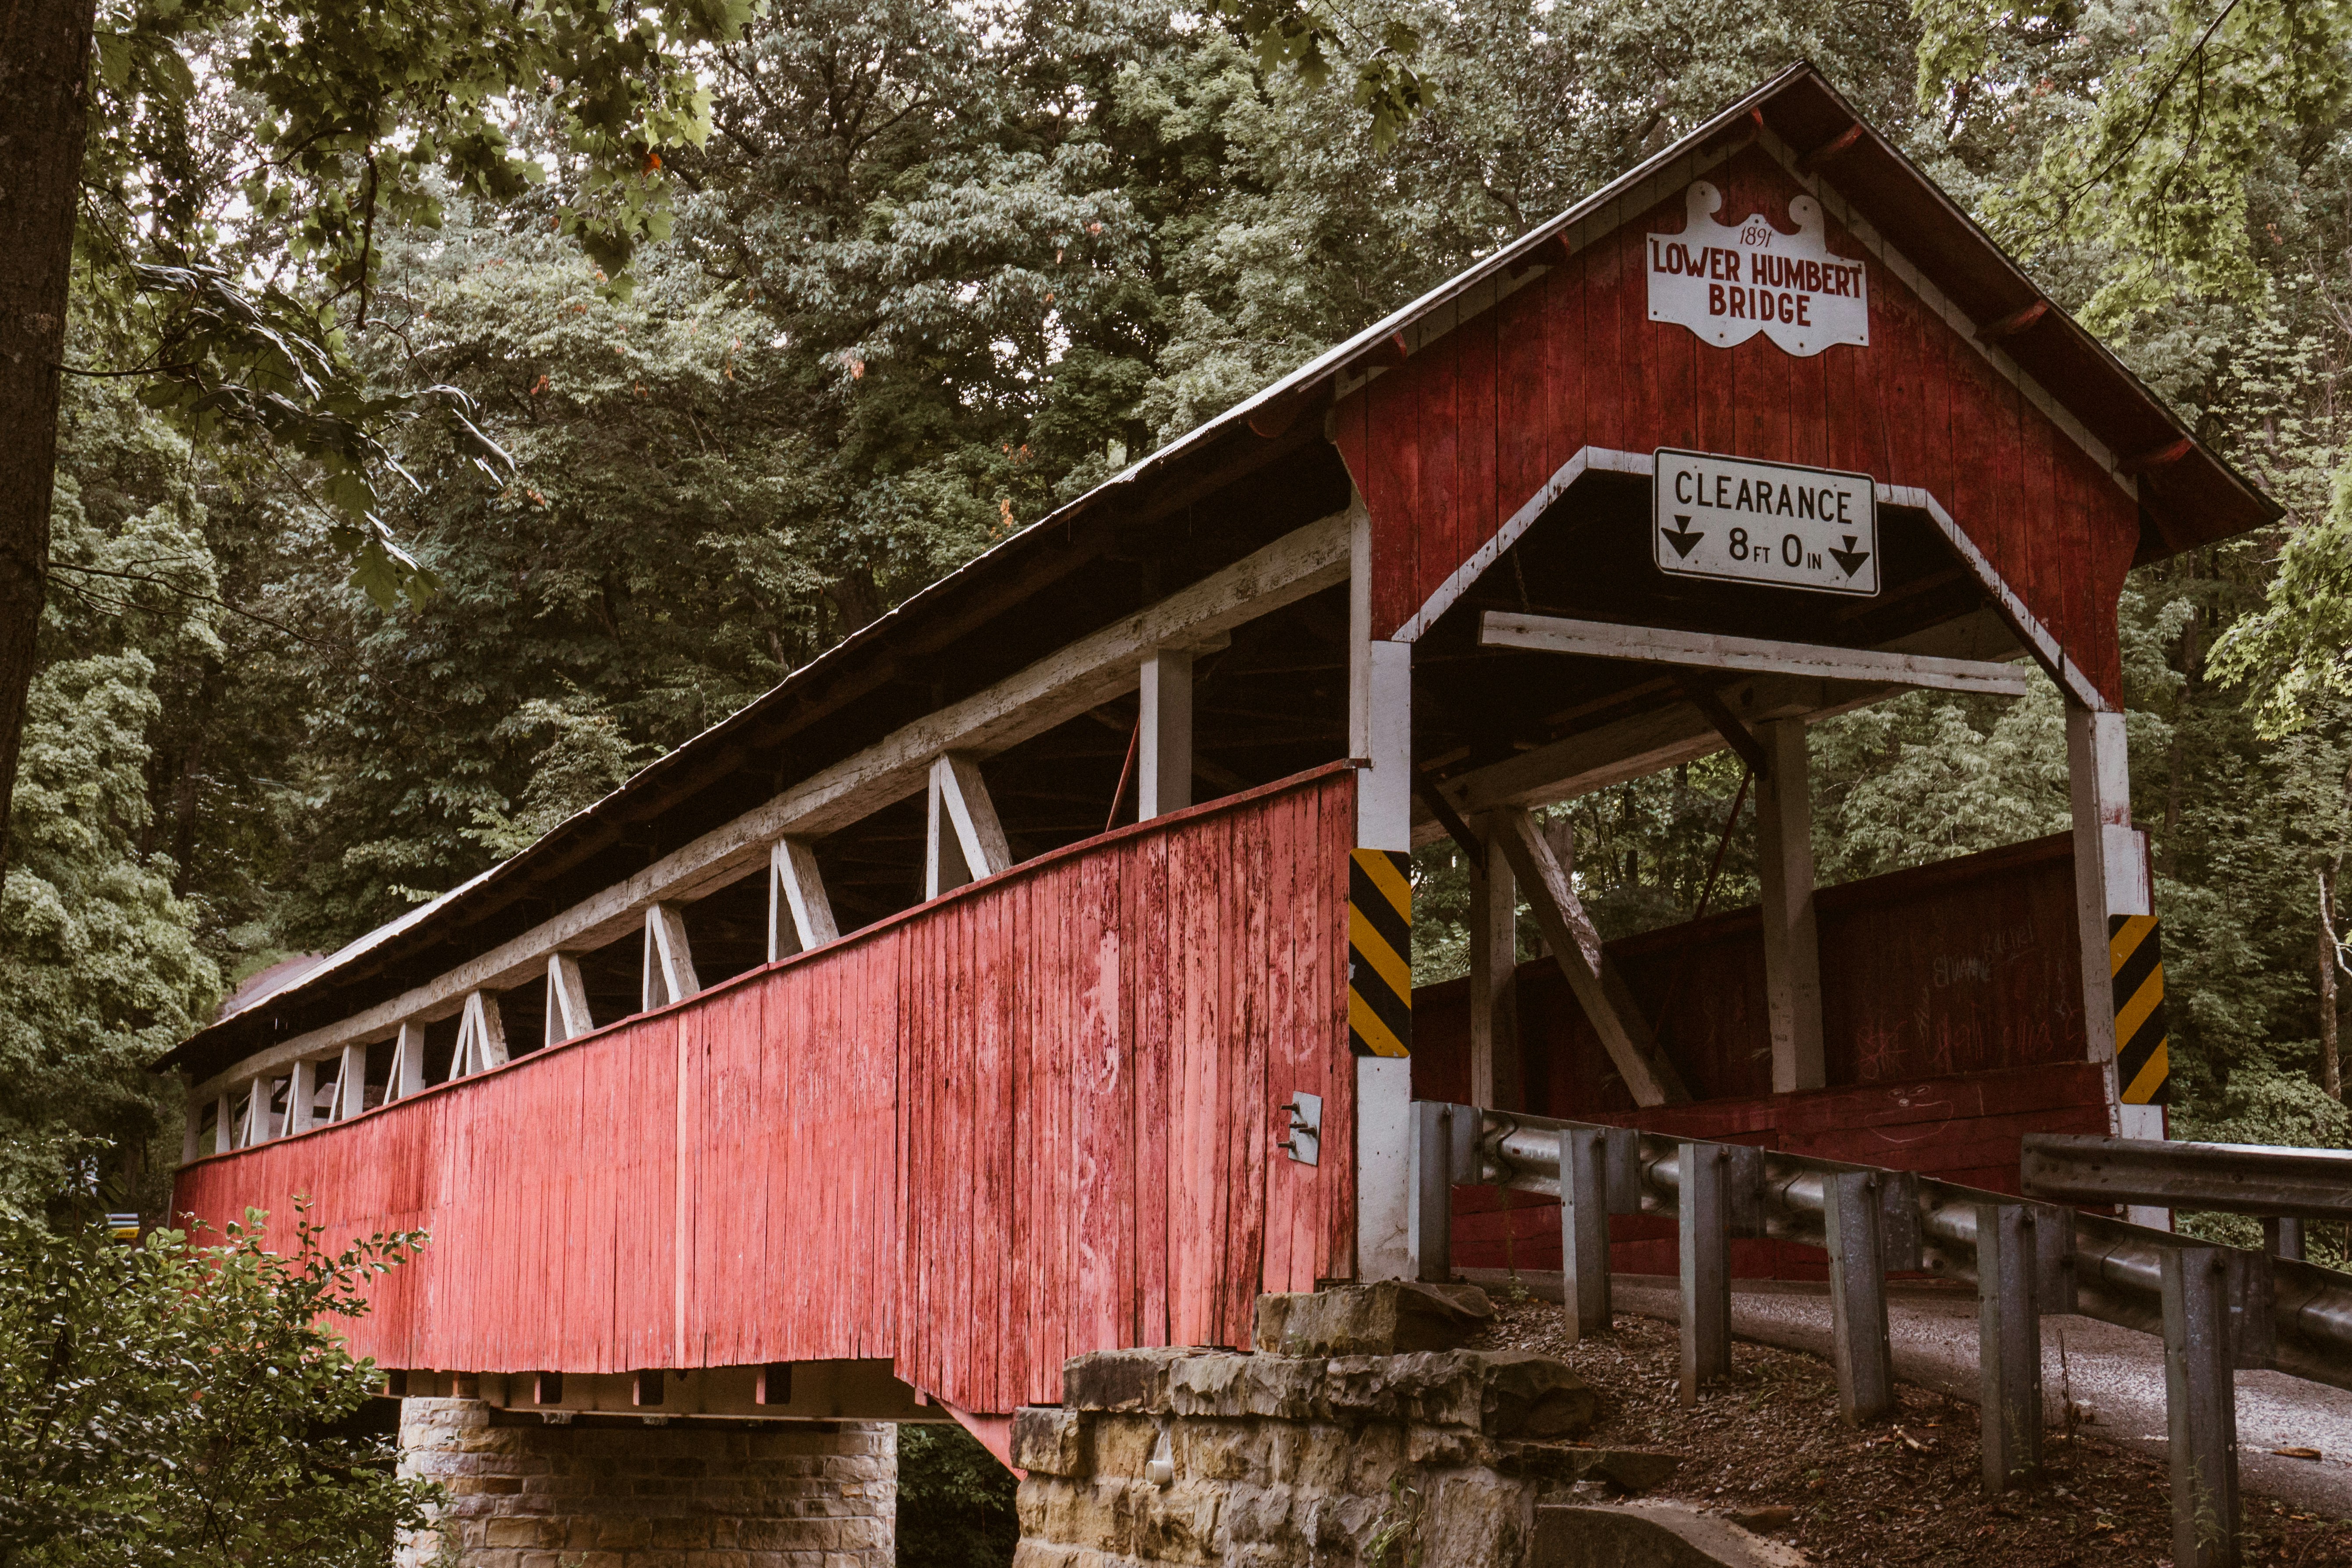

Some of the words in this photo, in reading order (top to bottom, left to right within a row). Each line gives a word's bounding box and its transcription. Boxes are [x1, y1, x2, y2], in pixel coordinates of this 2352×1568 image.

[1740, 226, 1773, 248] 1891
[1653, 240, 1740, 282] LOWER
[1751, 253, 1862, 298] HUMBERT
[1709, 283, 1811, 327] BRIDGE
[1675, 470, 1852, 525] CLEARANCE
